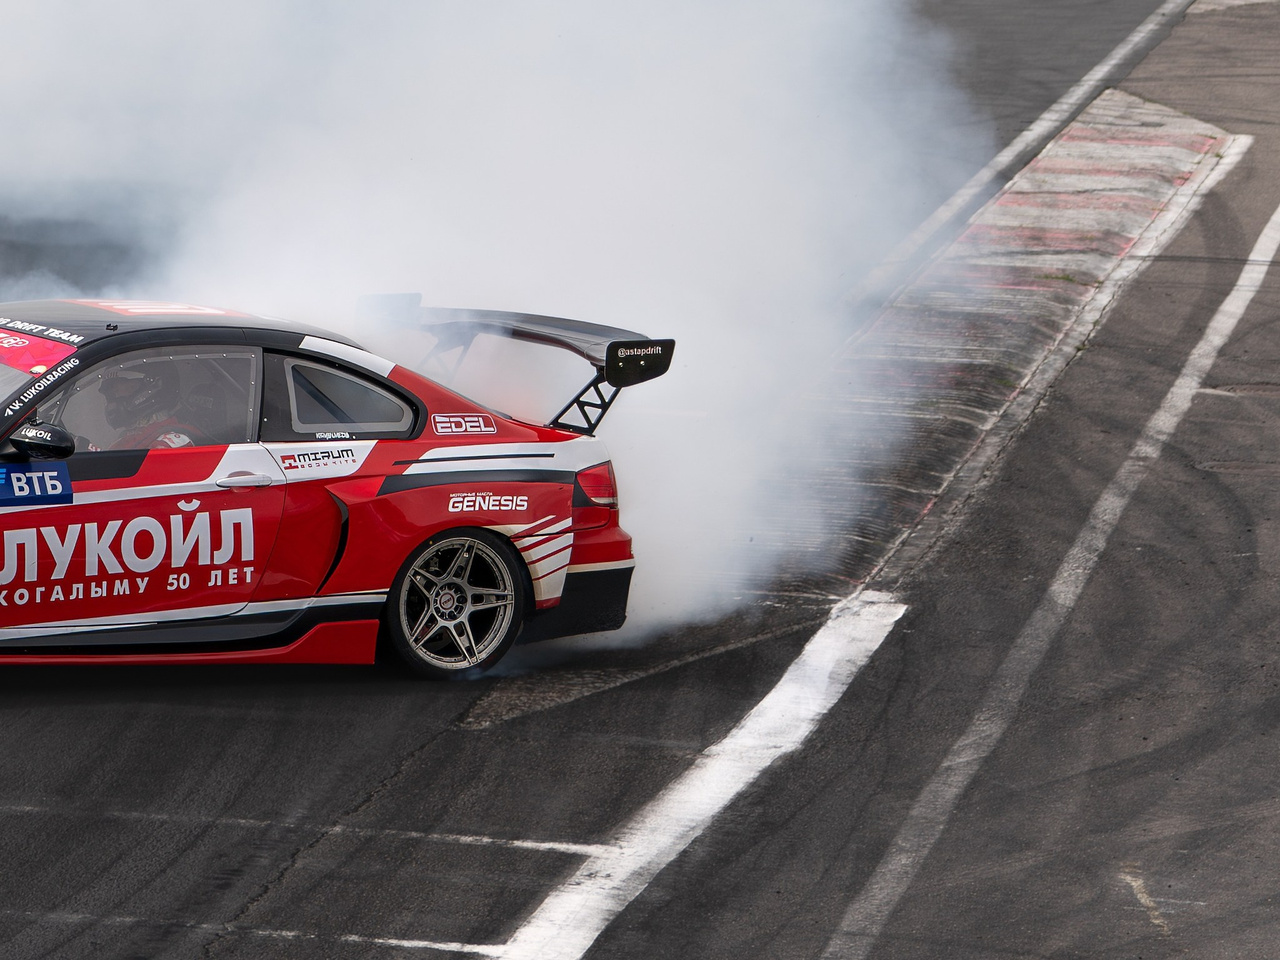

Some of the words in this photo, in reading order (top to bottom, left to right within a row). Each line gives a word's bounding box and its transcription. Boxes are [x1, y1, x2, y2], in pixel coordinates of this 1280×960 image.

[6, 320, 41, 335] DRIFT
[43, 328, 84, 343] TEAM
[617, 346, 662, 358] @astapdrift
[20, 358, 80, 403] LUKOILRACING
[21, 427, 52, 441] LUKOIL
[435, 415, 495, 433] EDEL
[10, 471, 63, 497] ВТБ
[448, 495, 529, 513] GENESIS
[166, 572, 191, 591] 50
[207, 566, 255, 587] ЛЕТ
